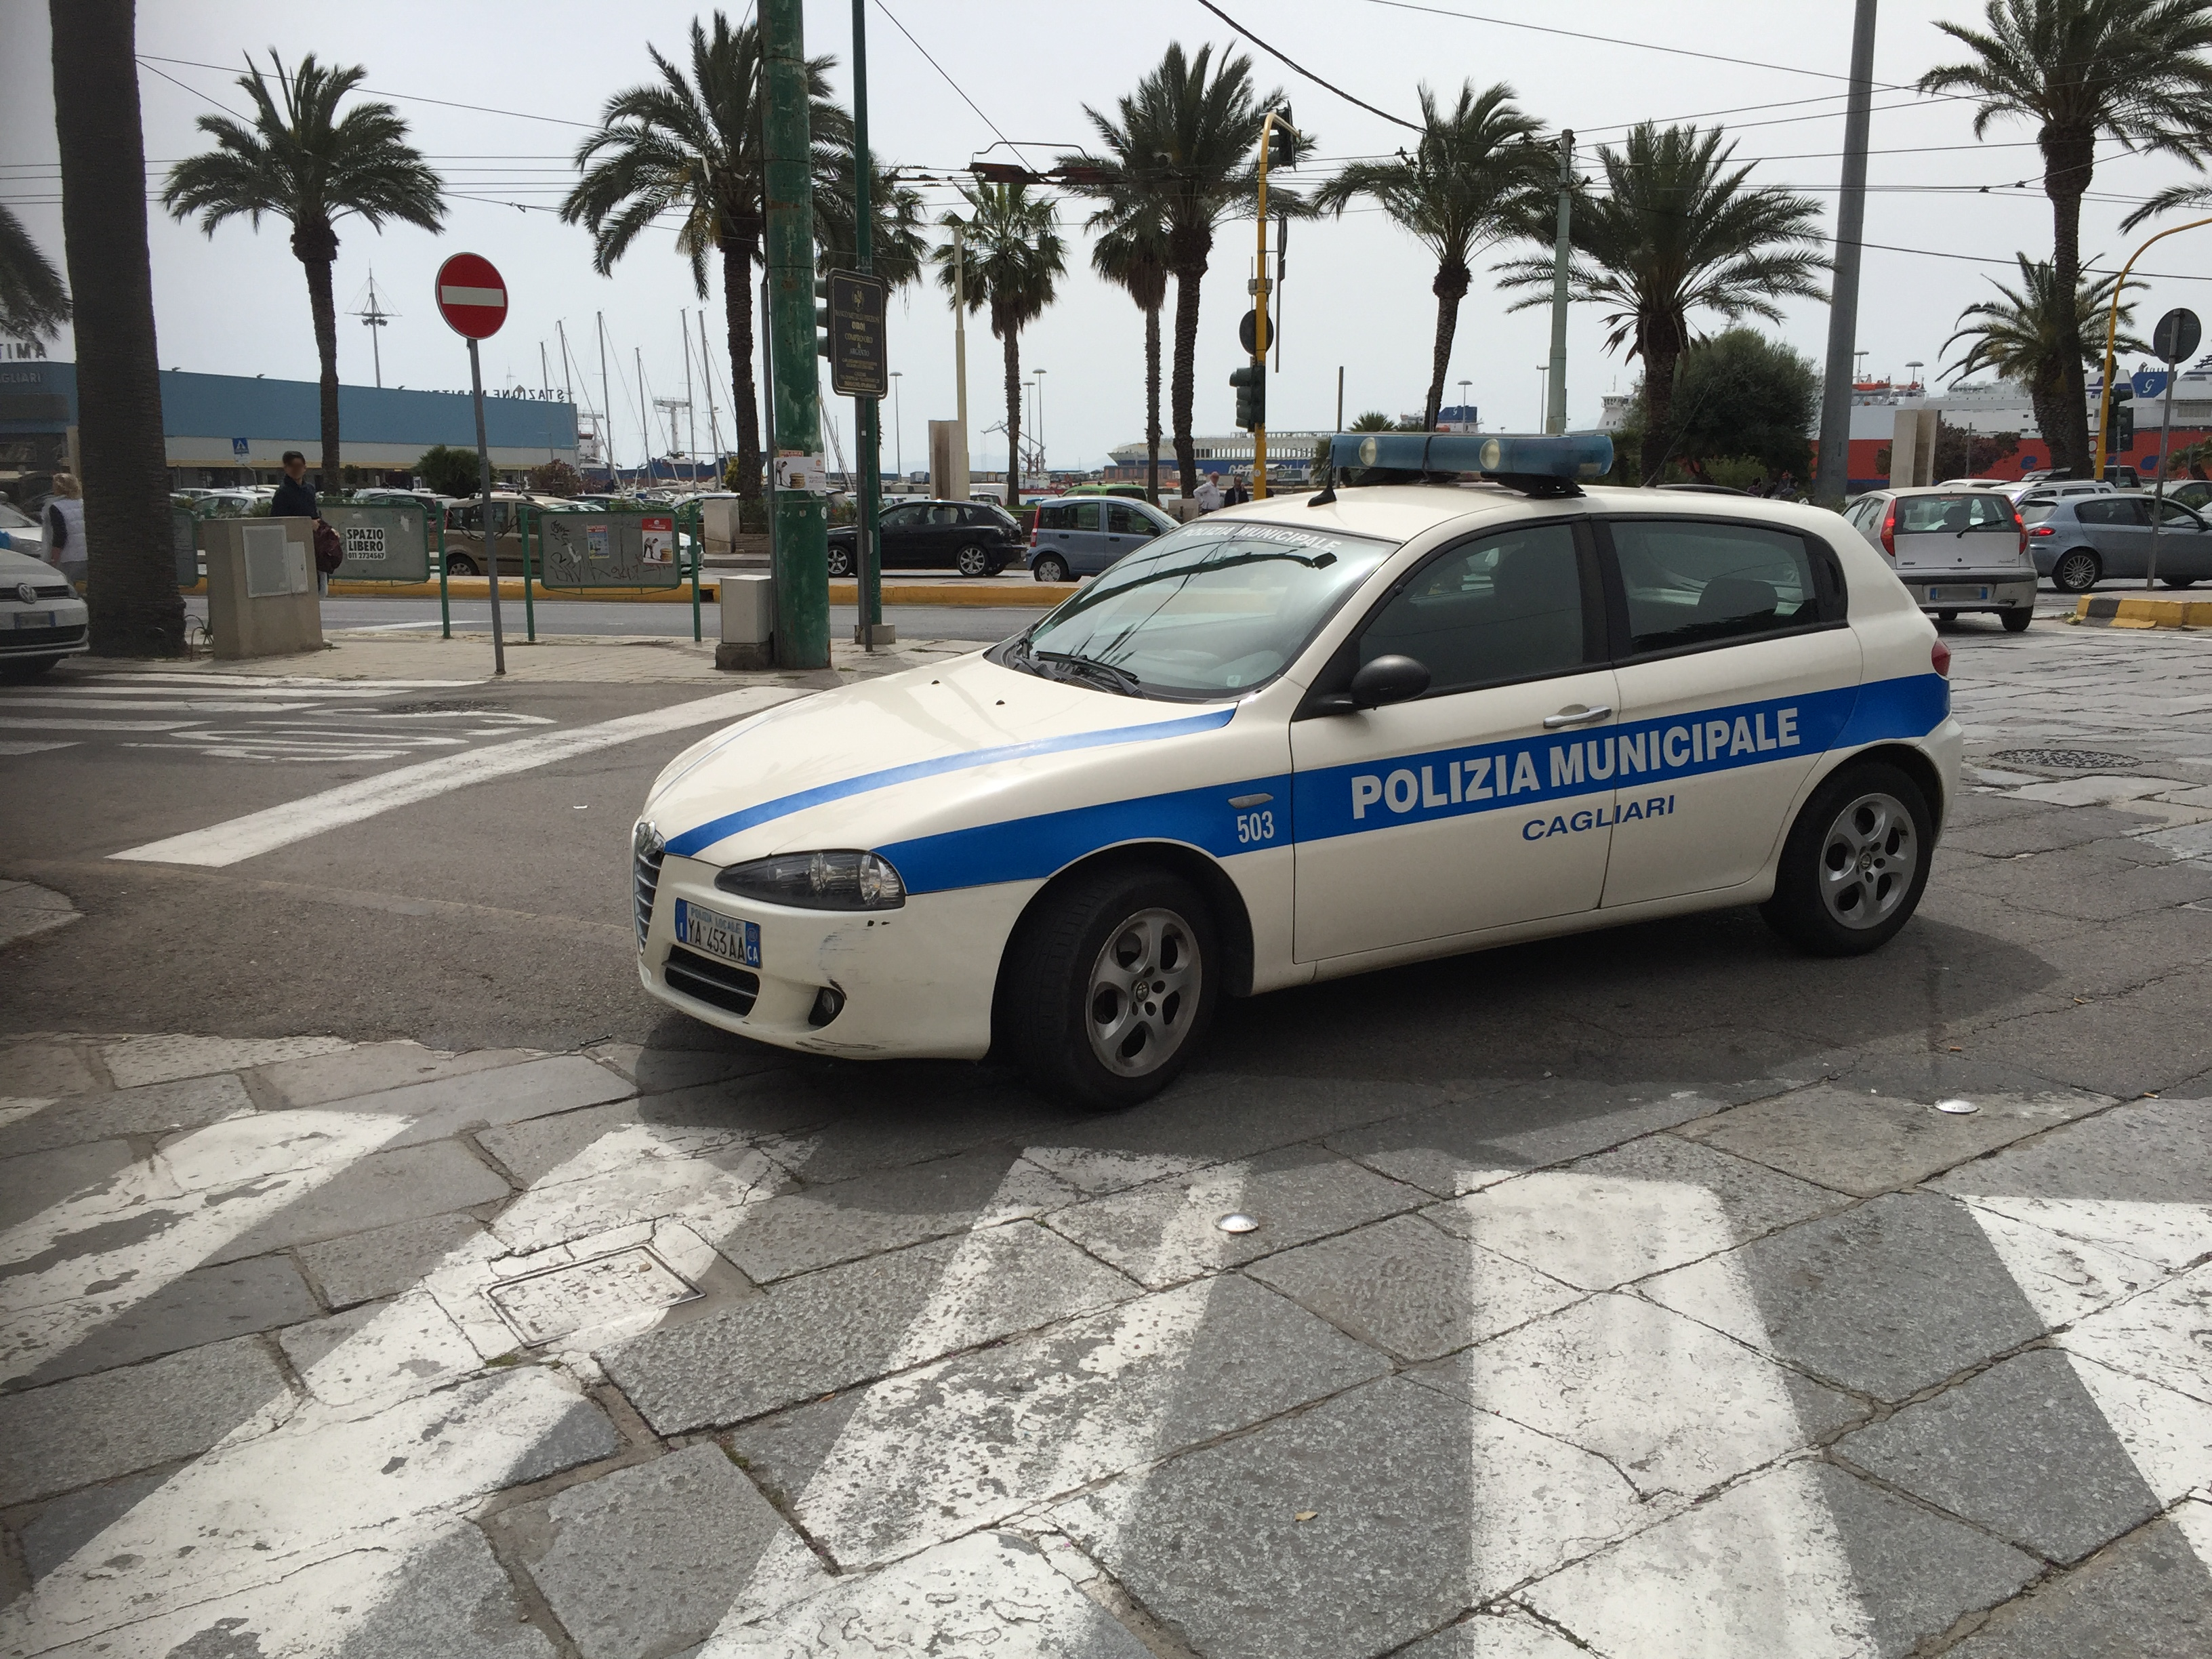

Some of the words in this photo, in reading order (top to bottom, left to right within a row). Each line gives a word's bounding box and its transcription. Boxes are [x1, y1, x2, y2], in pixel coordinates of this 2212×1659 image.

[849, 348, 869, 356] ARGENTO
[0, 373, 41, 383] GLIARI
[347, 529, 384, 539] SPAZIO
[348, 541, 384, 552] LIBERO
[1178, 527, 1235, 538] POLIZIA
[1235, 527, 1342, 552] MUNICIPALE
[1351, 751, 1540, 820] POLIZIA
[1549, 707, 1800, 788] MUNICIPALE
[1237, 811, 1274, 843] 503
[1521, 794, 1675, 841] CAGLIARI
[688, 918, 701, 945] YA
[691, 907, 712, 923] POLIZIA
[715, 917, 741, 934] LOCALE
[747, 945, 759, 962] CA
